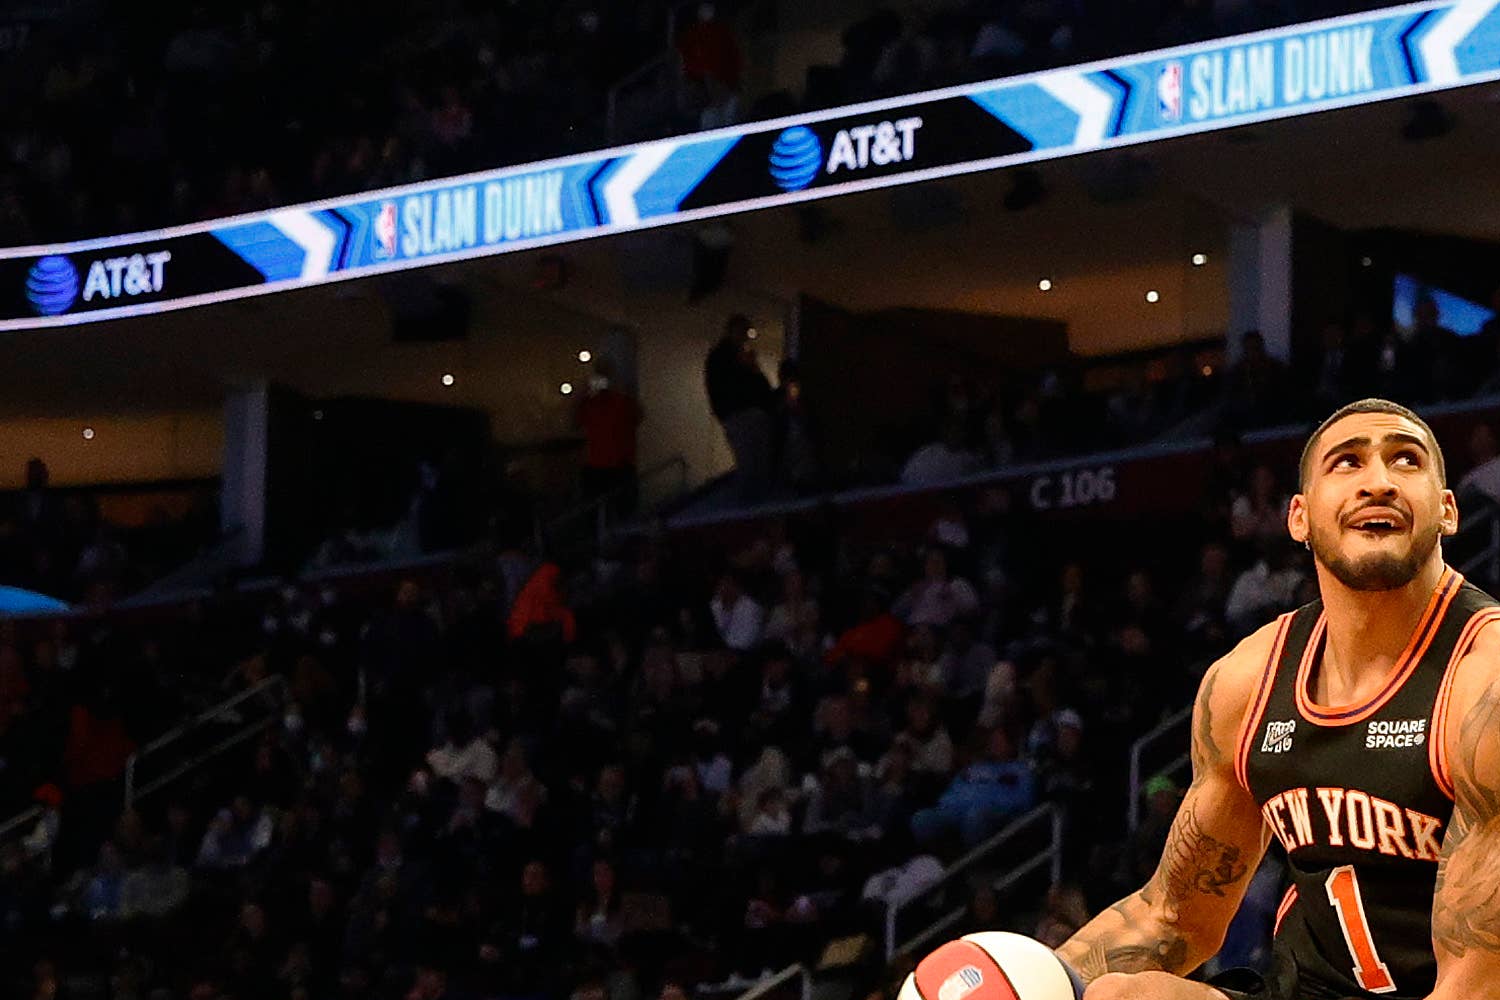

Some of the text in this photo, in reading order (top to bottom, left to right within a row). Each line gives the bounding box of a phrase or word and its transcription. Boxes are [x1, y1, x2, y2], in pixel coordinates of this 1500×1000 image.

[1189, 26, 1374, 119] SLAM DUNK
[826, 116, 923, 174] AT&T
[403, 171, 563, 257] SLAM DUNK
[83, 250, 171, 302] AT&T
[1058, 466, 1117, 507] 106
[1365, 733, 1414, 748] SPACE
[1367, 719, 1427, 735] SQUARE
[1316, 788, 1443, 862] YORK
[1325, 864, 1397, 994] 1
